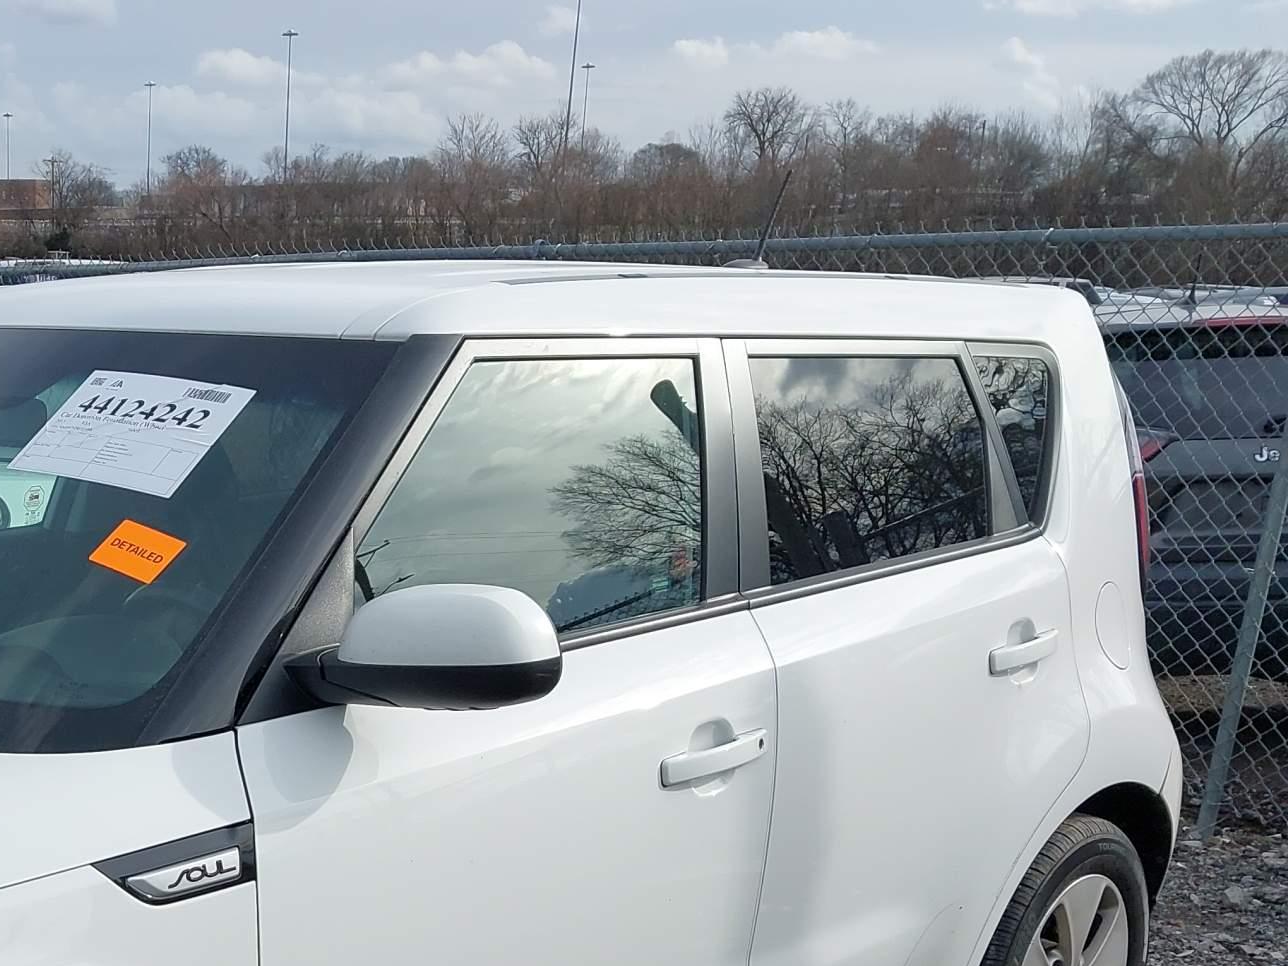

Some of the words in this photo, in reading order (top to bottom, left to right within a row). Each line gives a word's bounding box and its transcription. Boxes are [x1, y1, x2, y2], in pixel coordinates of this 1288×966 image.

[78, 394, 211, 429] 44124242
[1254, 446, 1280, 462] Je
[110, 537, 164, 564] DETAILED
[167, 859, 237, 890] SOUL
